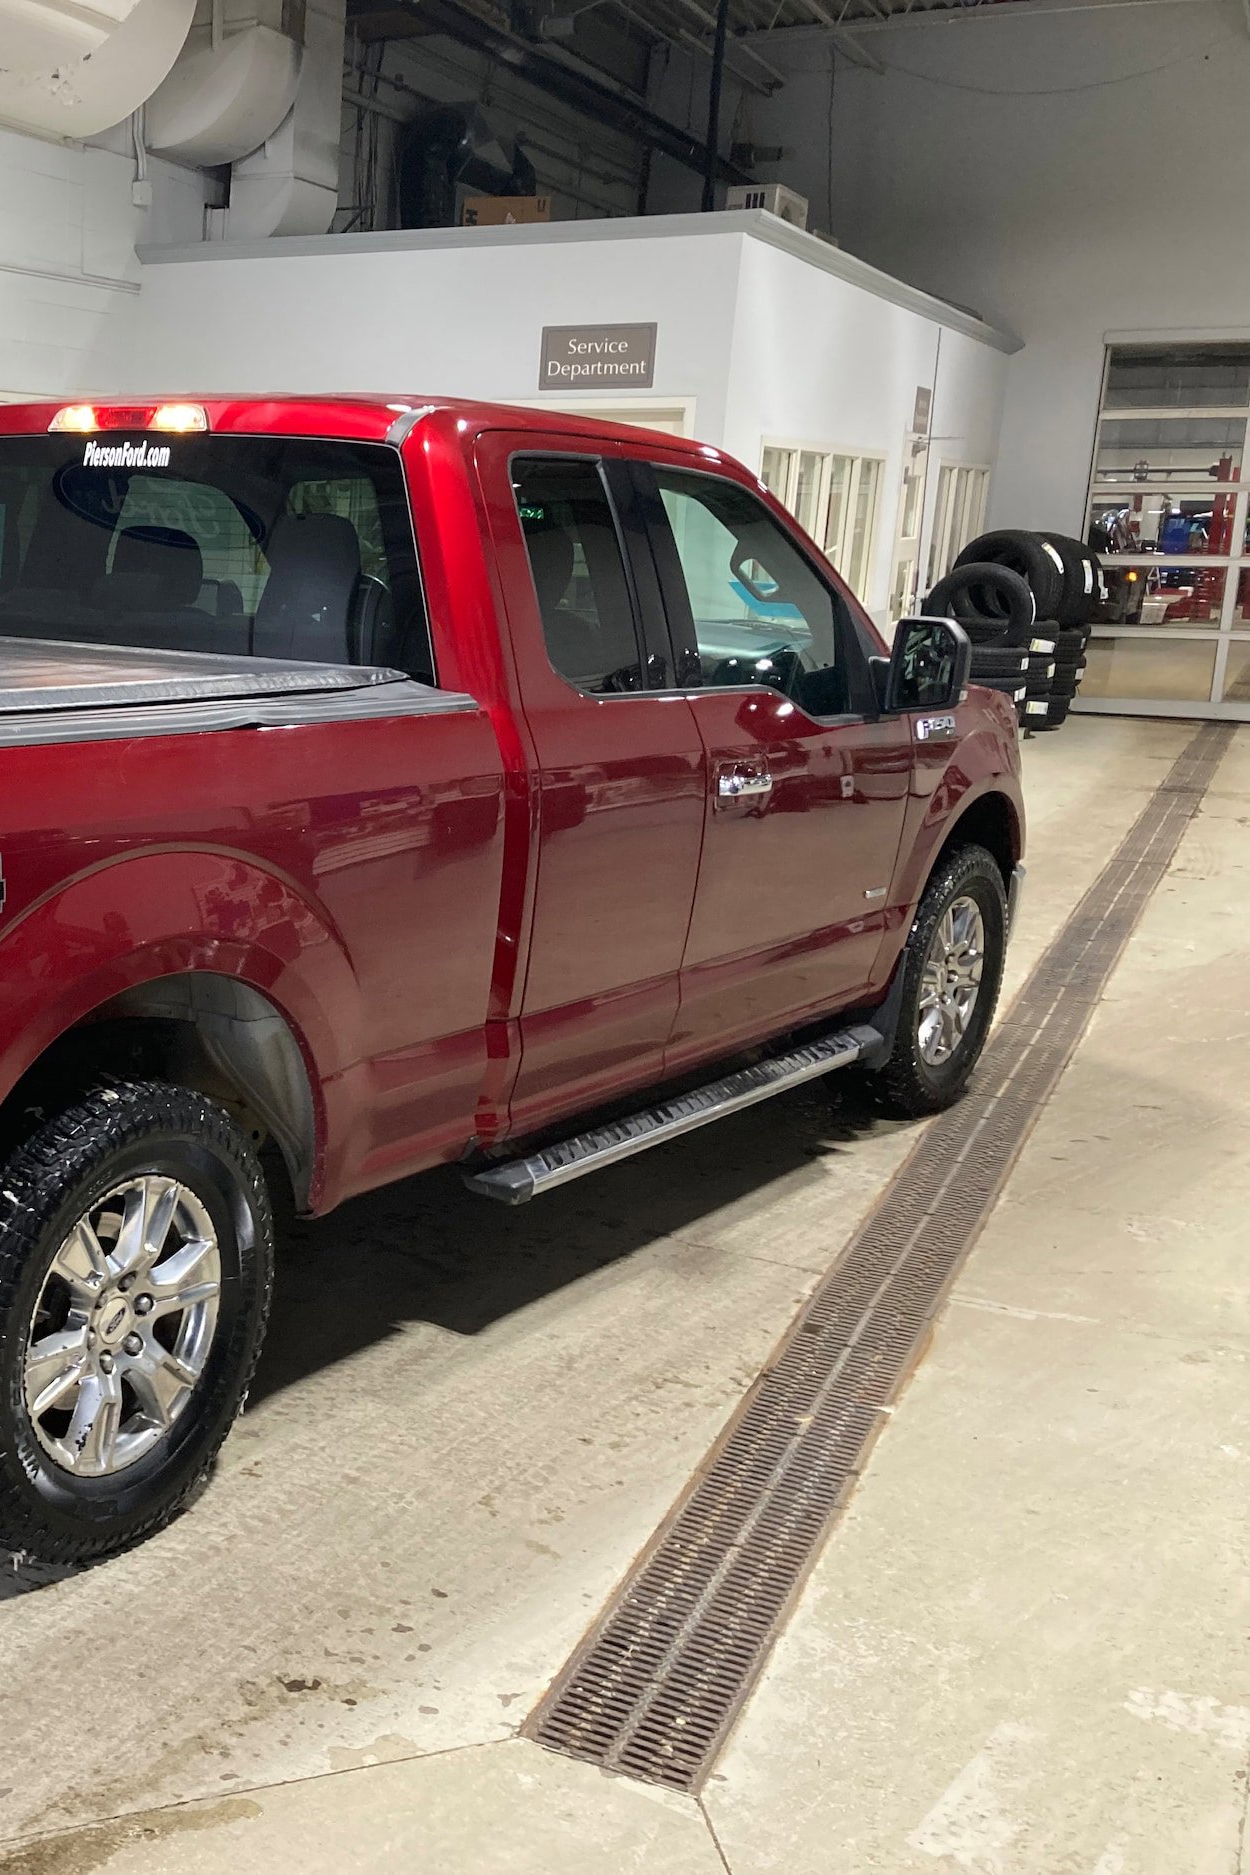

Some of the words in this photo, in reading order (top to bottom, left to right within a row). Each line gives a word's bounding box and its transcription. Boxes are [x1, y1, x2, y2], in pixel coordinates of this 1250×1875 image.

[567, 337, 629, 355] Service
[547, 360, 647, 381] Department
[83, 440, 170, 467] PiersonFord.com
